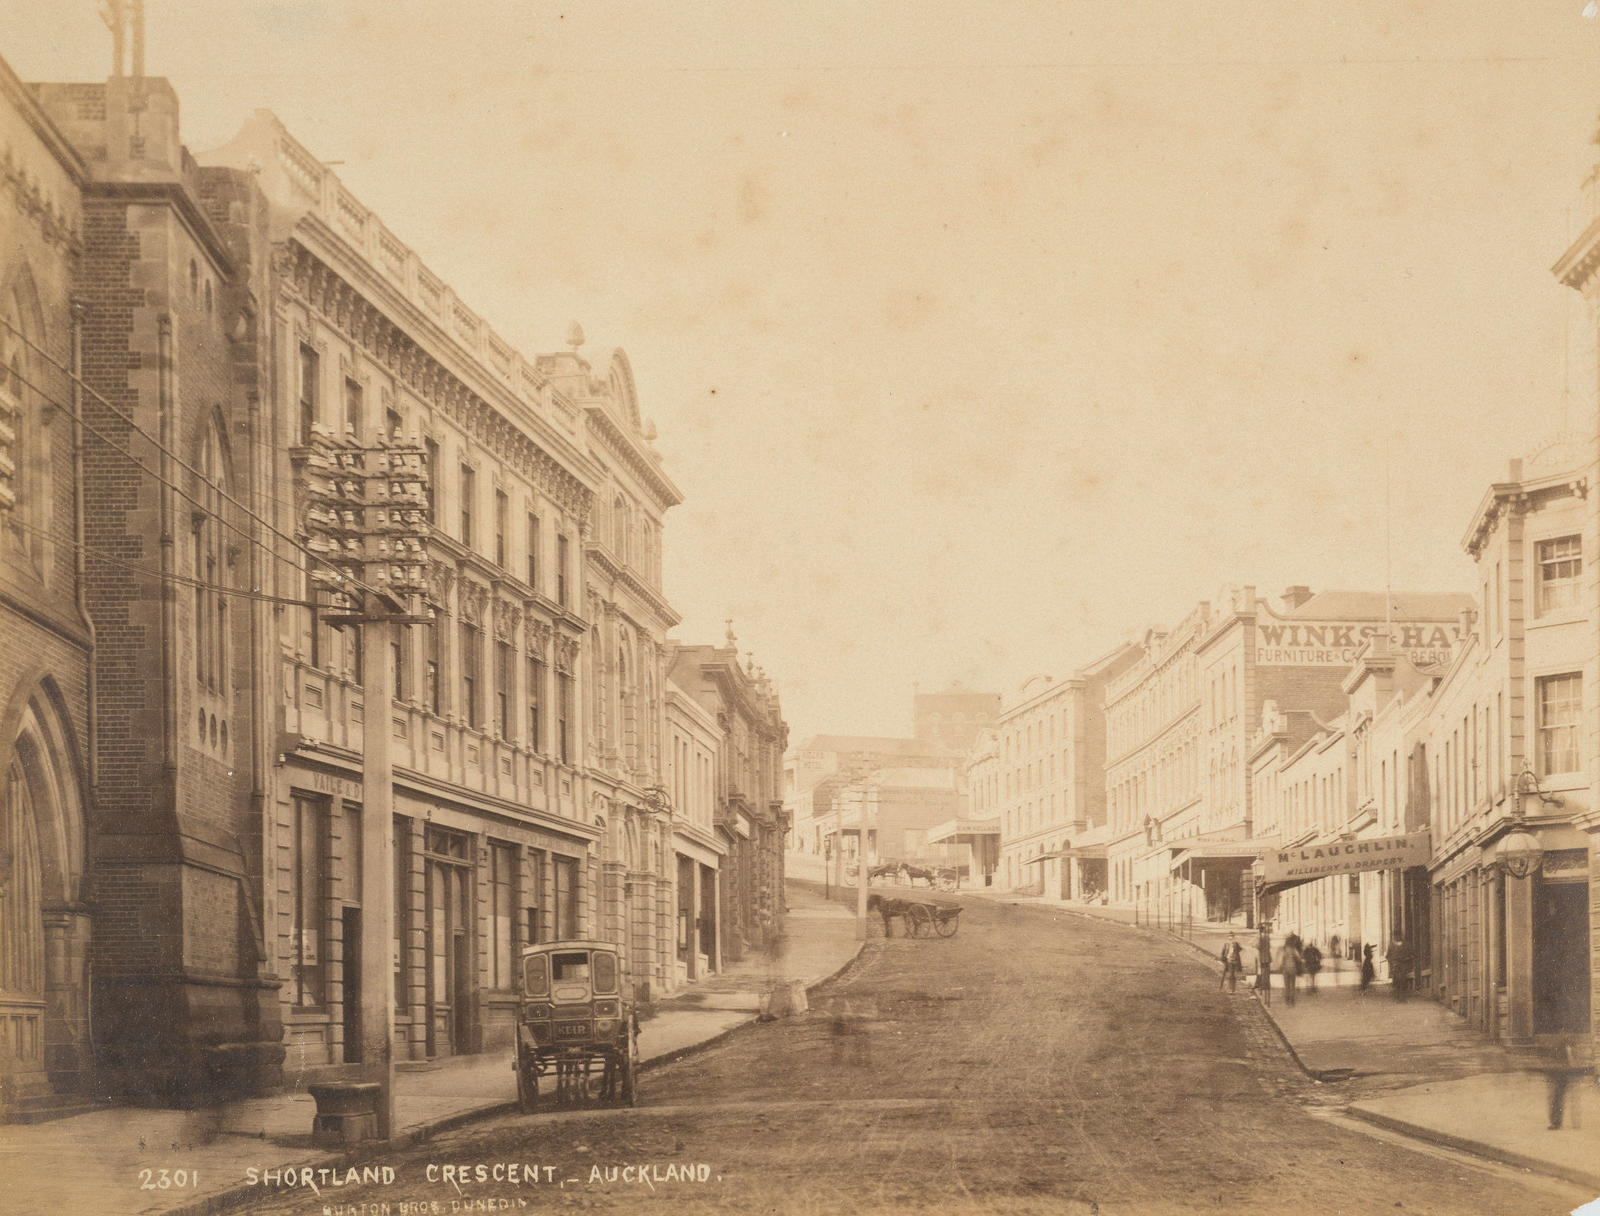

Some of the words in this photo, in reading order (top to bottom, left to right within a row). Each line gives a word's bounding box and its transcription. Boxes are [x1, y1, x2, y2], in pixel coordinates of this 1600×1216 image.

[1259, 624, 1378, 648] WINKS
[1401, 625, 1461, 648] HA
[1257, 648, 1334, 663] FURNITURE
[1286, 863, 1340, 876] MILLINERY
[1343, 862, 1351, 870] &
